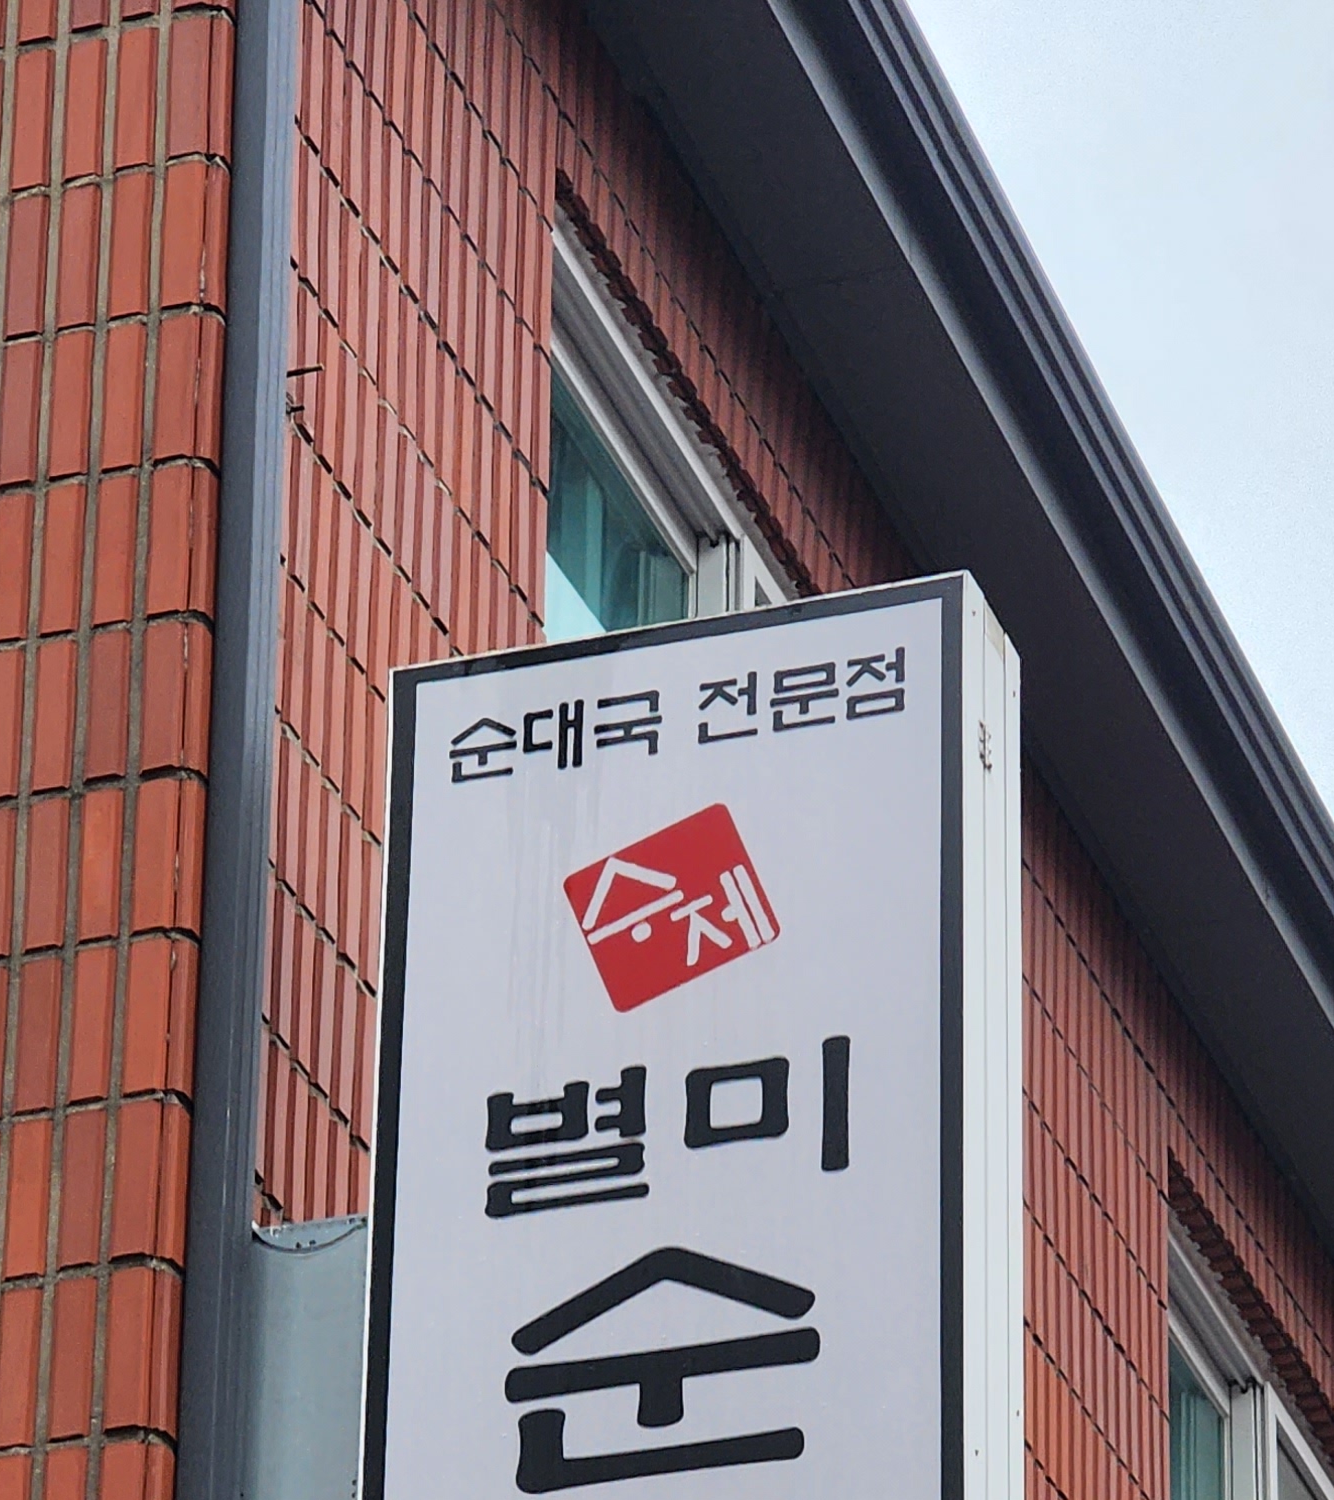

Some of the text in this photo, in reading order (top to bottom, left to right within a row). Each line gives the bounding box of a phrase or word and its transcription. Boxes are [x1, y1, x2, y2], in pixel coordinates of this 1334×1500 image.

[450, 647, 905, 783] 순대국 전문점
[581, 856, 775, 967] 수제
[485, 1036, 850, 1219] 별미
